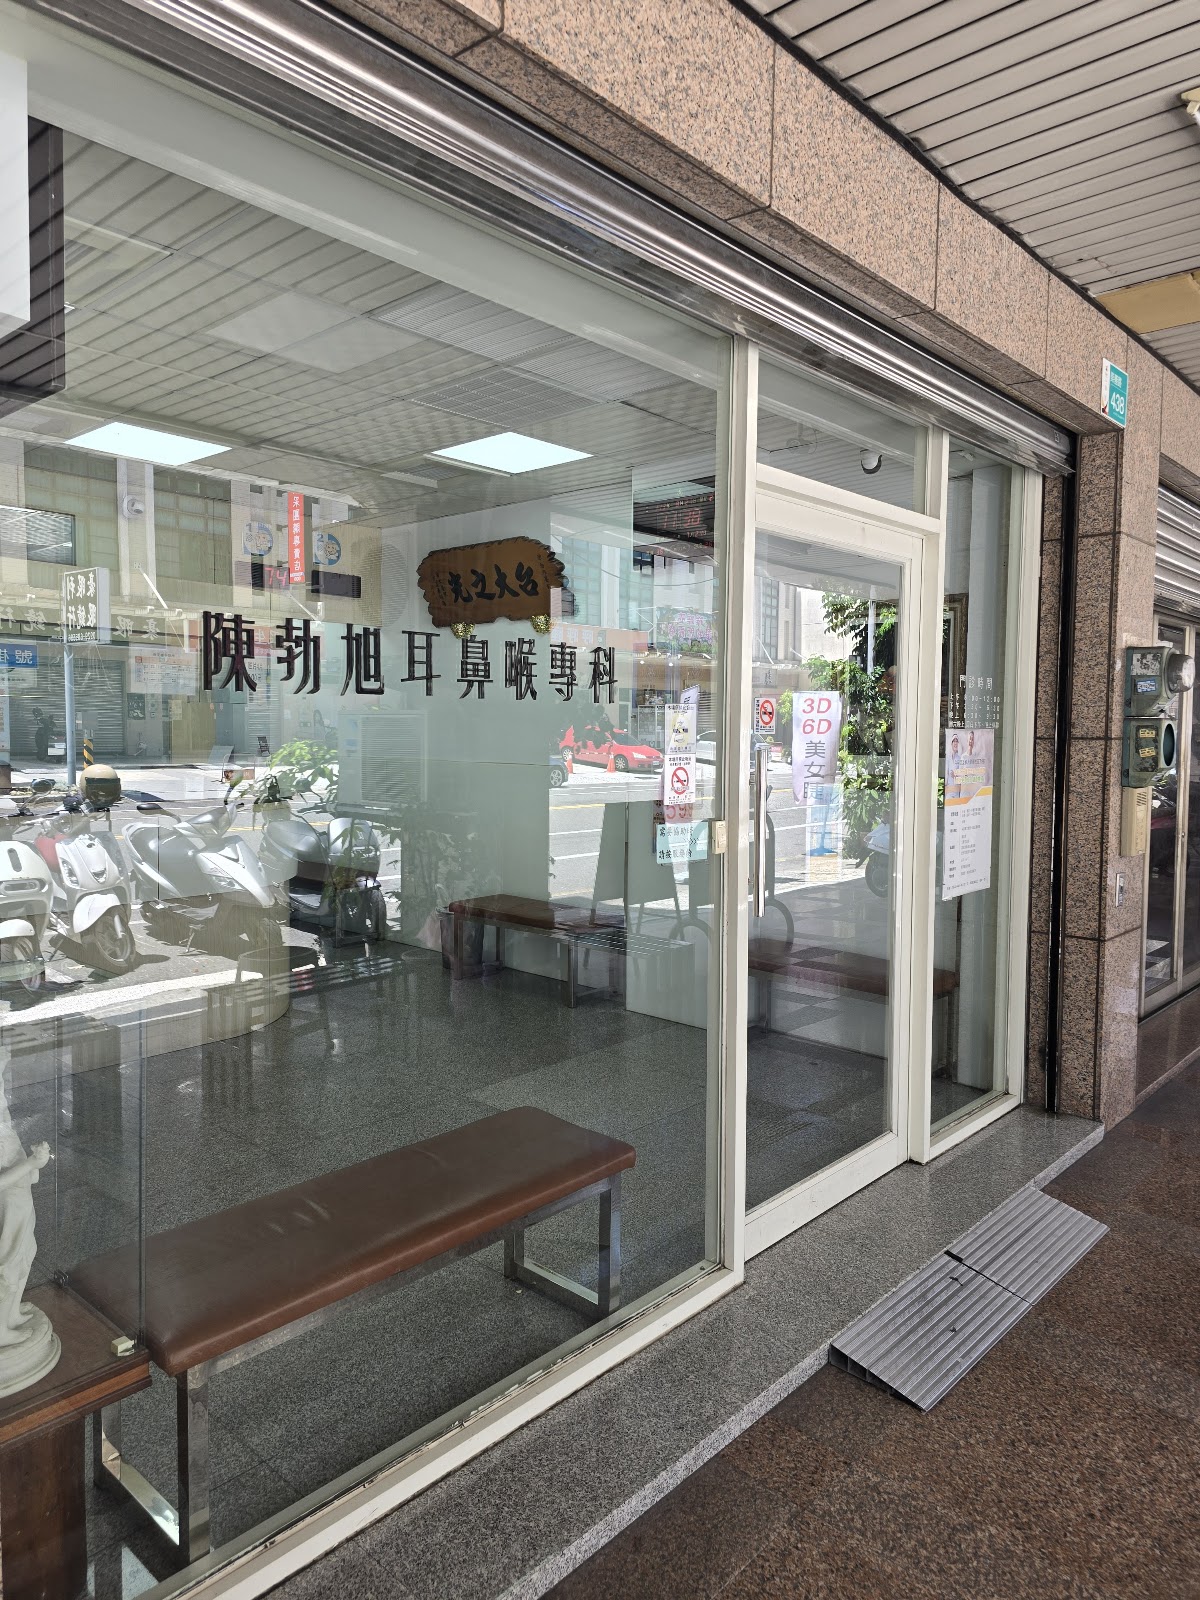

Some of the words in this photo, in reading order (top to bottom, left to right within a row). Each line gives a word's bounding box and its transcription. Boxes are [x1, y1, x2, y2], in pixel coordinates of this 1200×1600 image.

[1110, 391, 1125, 415] 438
[264, 567, 287, 587] 74
[448, 561, 540, 604] 台大之光
[959, 674, 993, 690] 門診時間
[802, 697, 832, 714] 3D
[802, 718, 832, 735] 6D
[803, 740, 826, 800] 美女睫
